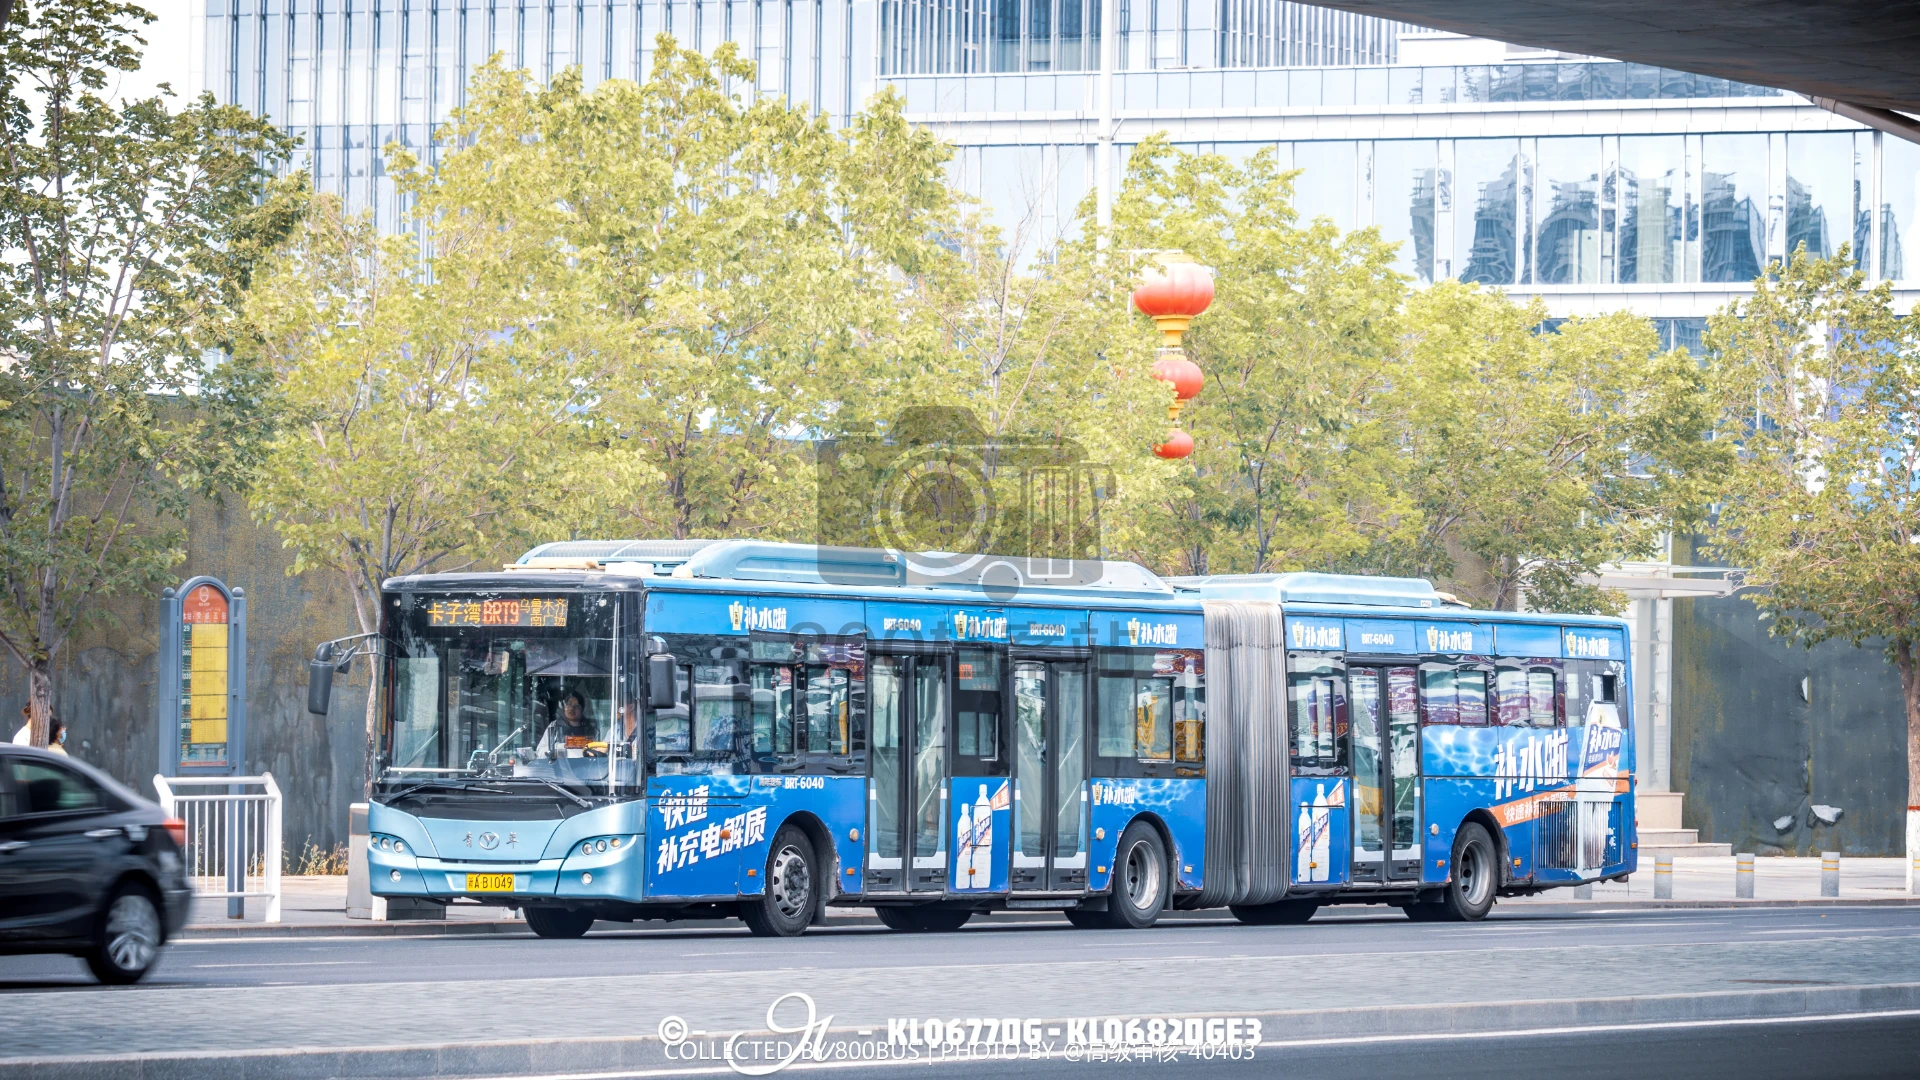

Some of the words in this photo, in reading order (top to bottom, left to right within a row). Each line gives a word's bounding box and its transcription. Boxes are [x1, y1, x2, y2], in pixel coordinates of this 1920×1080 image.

[427, 602, 480, 624] 卡子湾
[483, 601, 519, 625] BRT9
[520, 598, 567, 615] 乌鲁木齐
[744, 606, 787, 630] 补水啦
[883, 617, 922, 631] BRT-6040
[967, 616, 1007, 638] 补水啦
[1030, 623, 1065, 636] BRT-6040
[1140, 622, 1177, 644] 补水啦
[1304, 625, 1340, 647] 补水啦
[1361, 633, 1394, 645] BRT-6040
[1438, 630, 1473, 651] 补水啦
[1577, 636, 1609, 656] 补水啦
[1588, 725, 1621, 753] 补水啦
[1493, 728, 1569, 801] 补水啦
[784, 776, 824, 790] BRT-6040
[1103, 785, 1135, 804] 补水啦
[659, 785, 710, 830] 快速
[657, 806, 767, 875] 补充电解质
